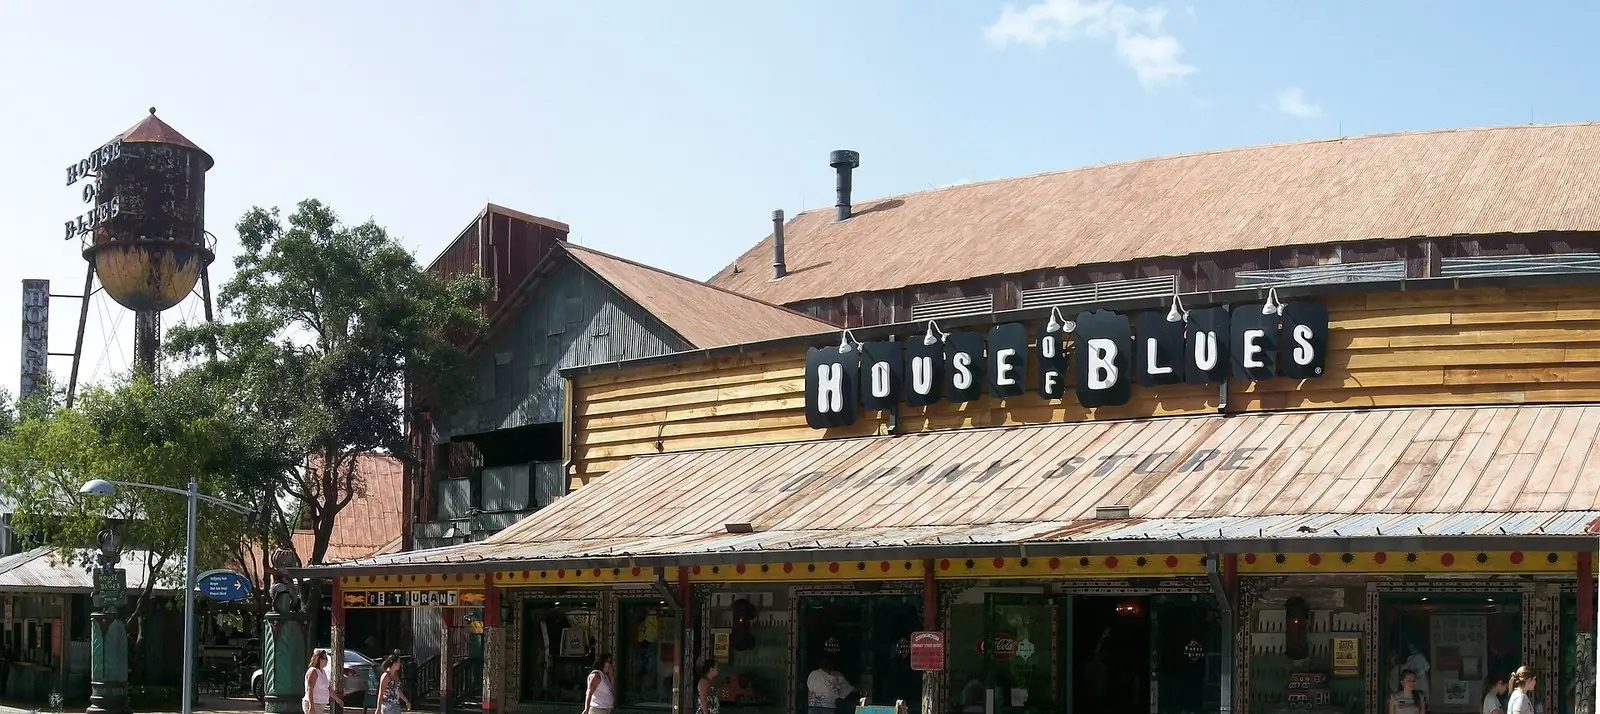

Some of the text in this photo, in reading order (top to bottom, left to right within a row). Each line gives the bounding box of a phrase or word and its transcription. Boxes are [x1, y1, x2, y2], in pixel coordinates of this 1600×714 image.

[65, 138, 123, 187] HOUSE
[82, 177, 104, 204] OF
[64, 195, 121, 241] BLUES
[26, 288, 44, 374] HOUSE
[817, 324, 1314, 413] HOUSE OF BLUES
[748, 447, 1268, 494] COMPANY STORE
[370, 593, 456, 604] RETURANT
